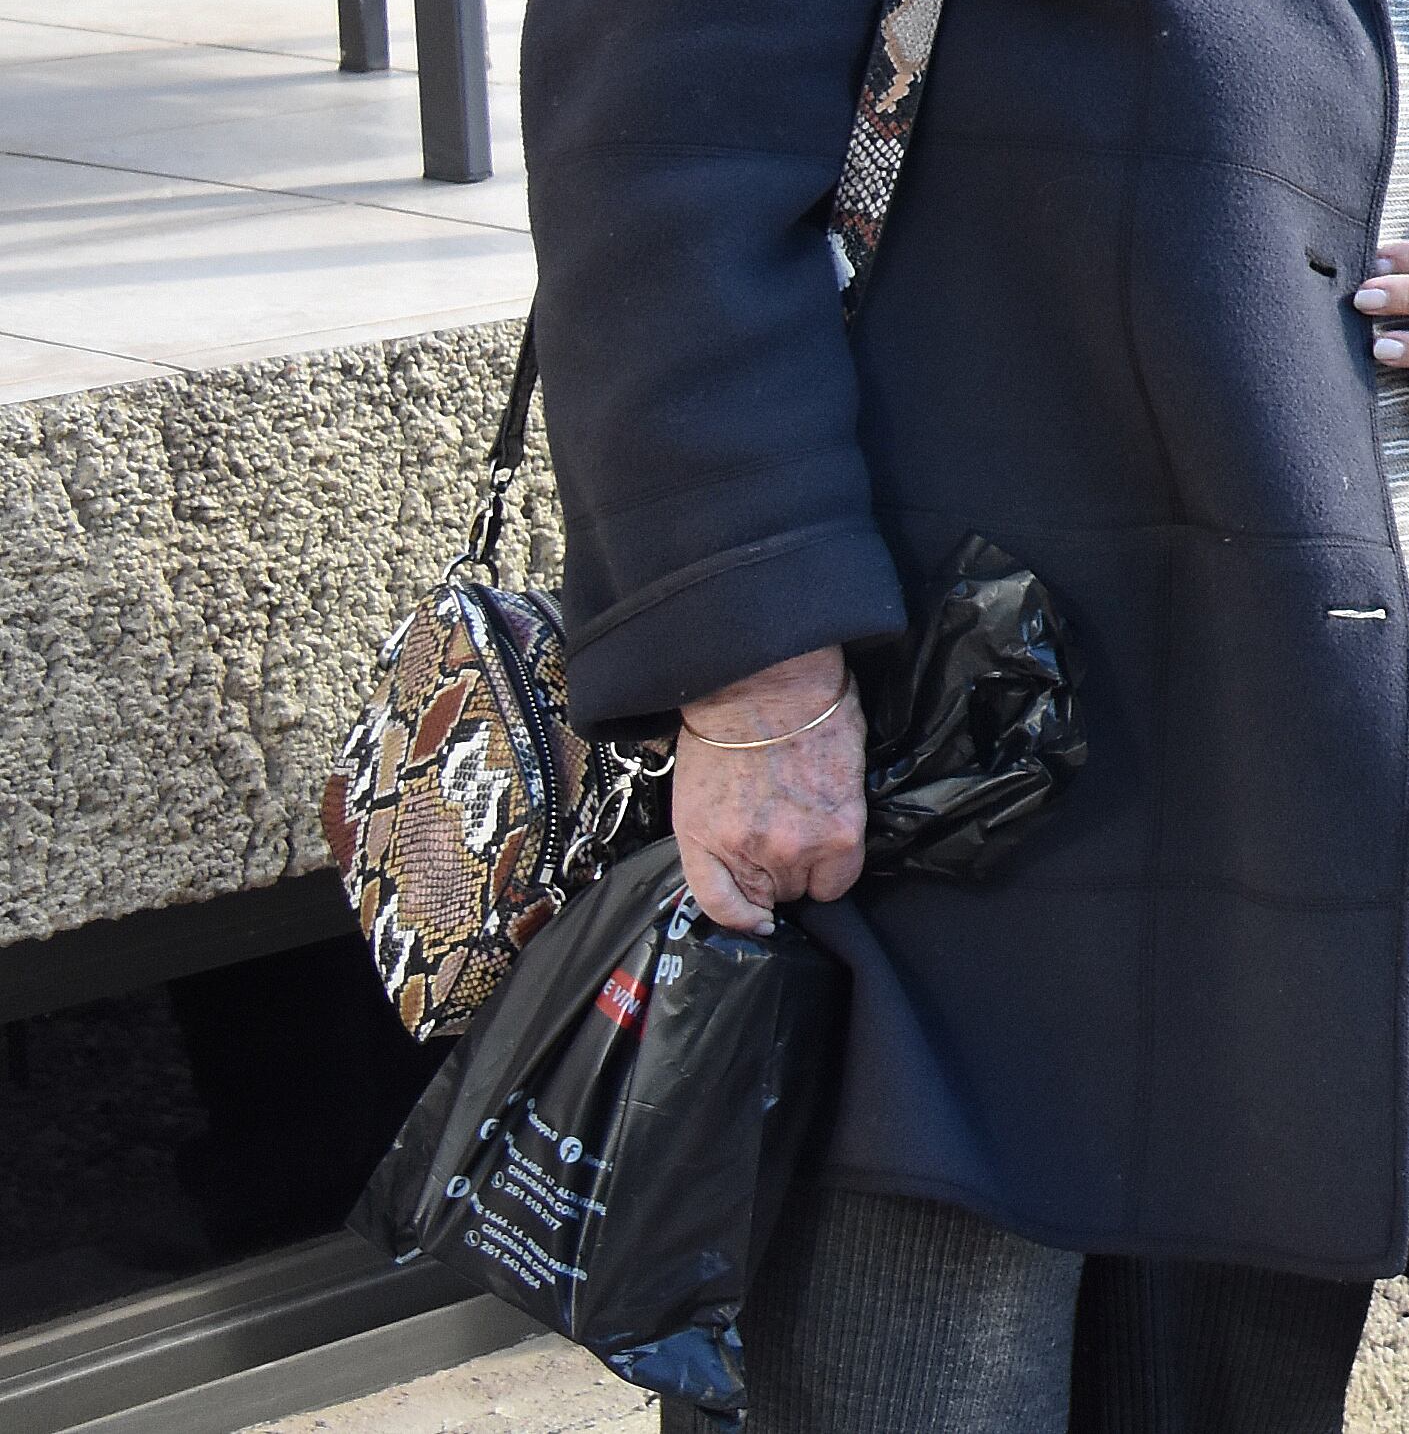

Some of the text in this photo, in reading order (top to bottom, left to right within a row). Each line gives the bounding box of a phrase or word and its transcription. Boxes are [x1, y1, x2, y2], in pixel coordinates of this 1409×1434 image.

[504, 1181, 526, 1201] 261
[481, 1223, 524, 1256] CHACRAS
[480, 1240, 502, 1260] 261
